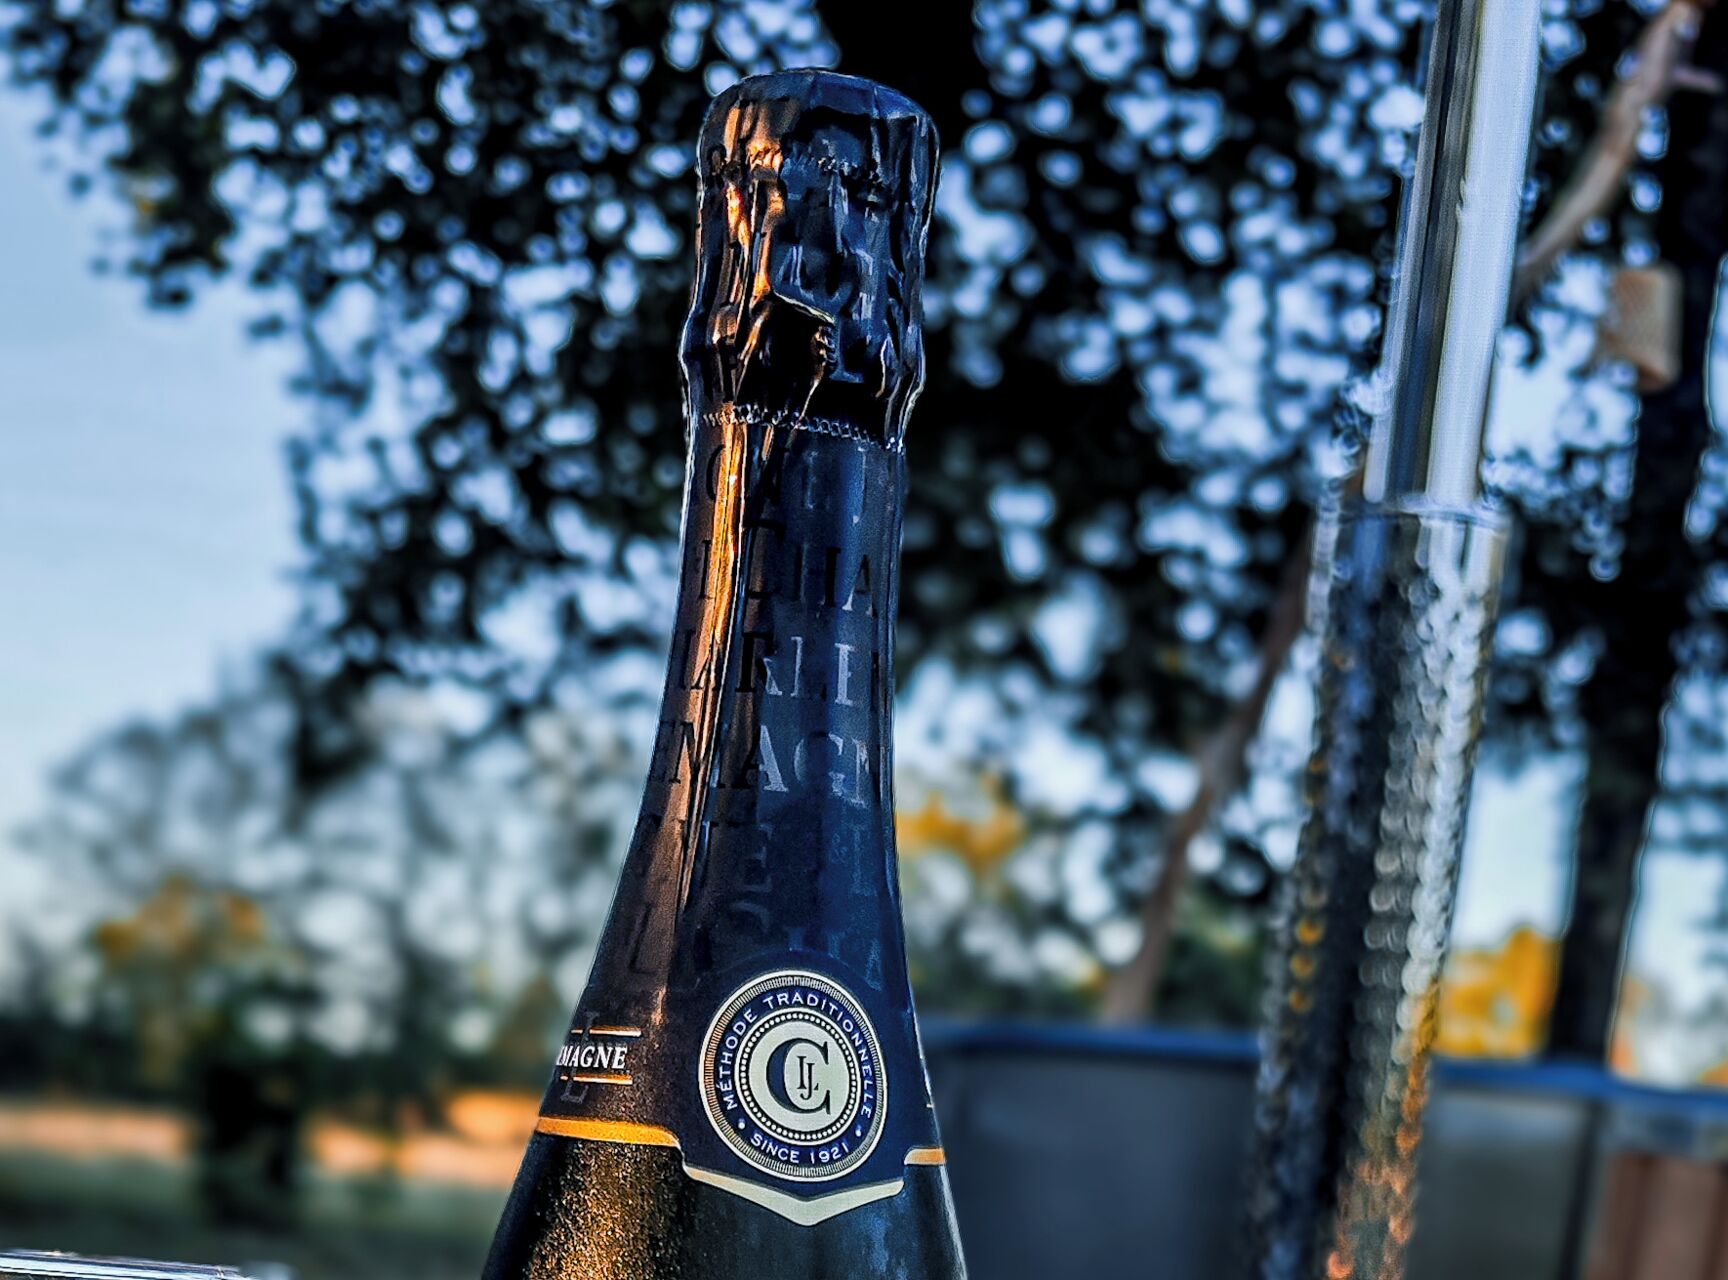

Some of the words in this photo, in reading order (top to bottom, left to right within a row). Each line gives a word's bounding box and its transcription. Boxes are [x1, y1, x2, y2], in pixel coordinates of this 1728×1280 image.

[716, 1008, 757, 1111] MÉTHODE
[762, 992, 873, 1119] TRADITIONNELLE
[750, 1132, 800, 1163] SINCE
[809, 1142, 850, 1165] 1921
